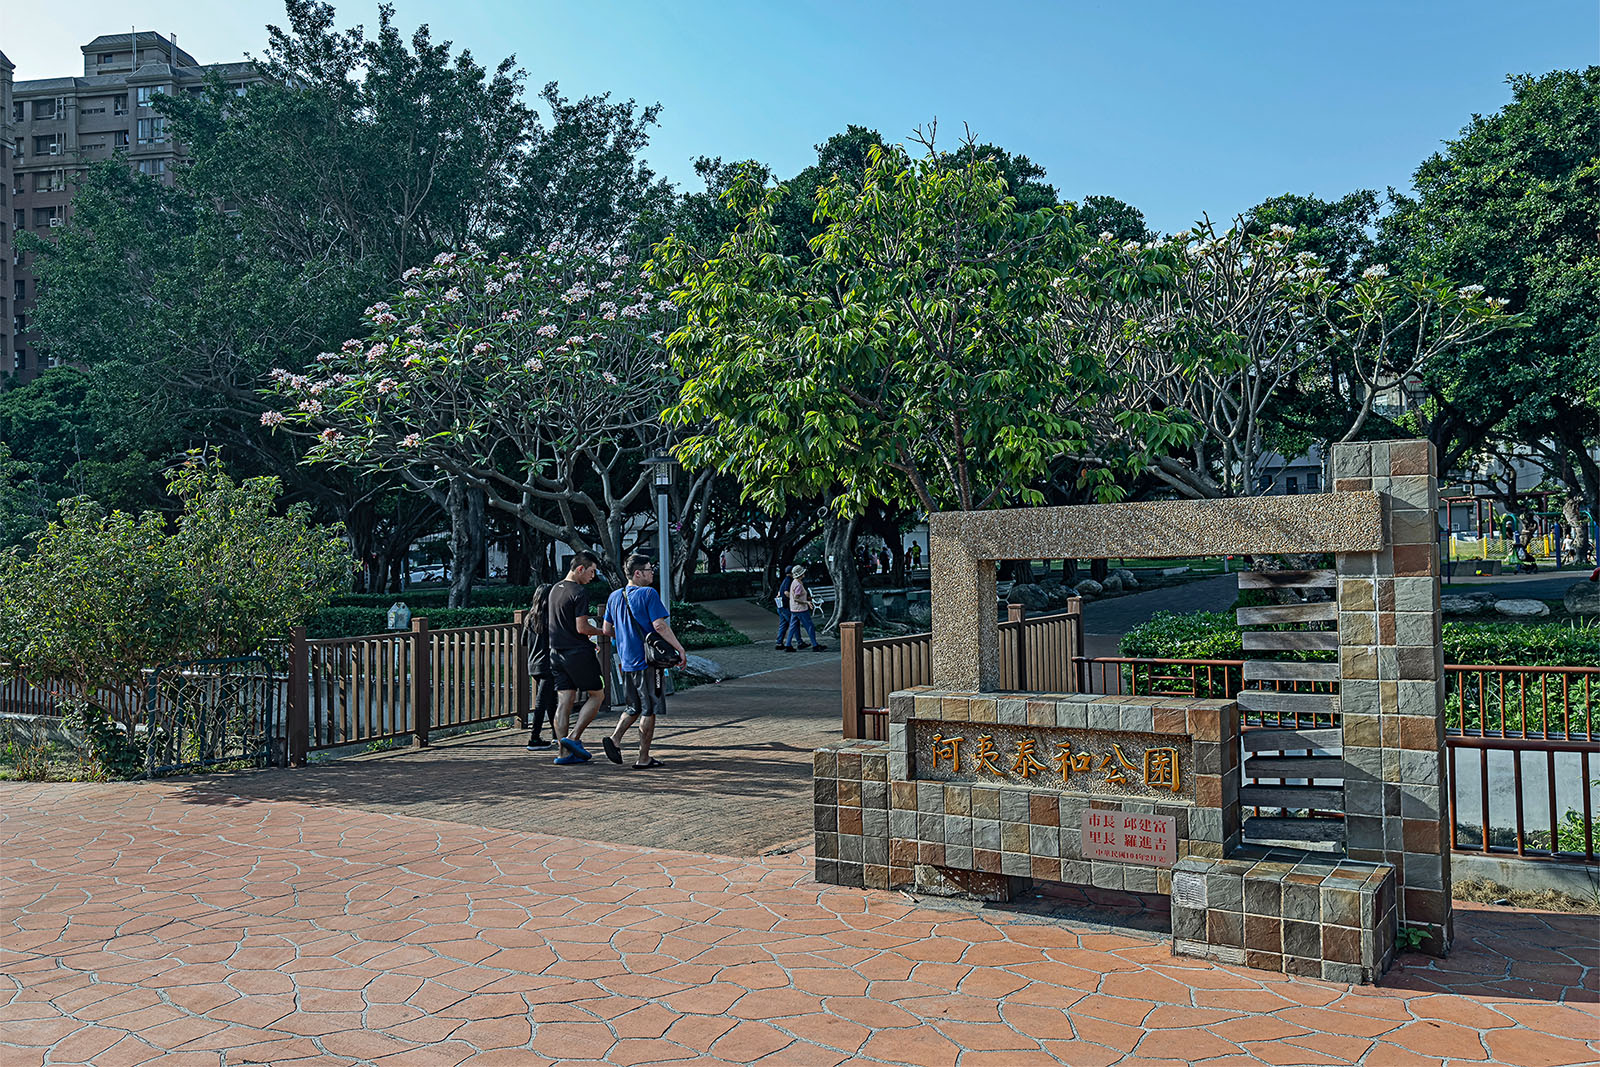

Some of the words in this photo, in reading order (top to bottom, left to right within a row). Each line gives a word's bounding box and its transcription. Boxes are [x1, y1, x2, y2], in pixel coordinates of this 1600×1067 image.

[932, 733, 1180, 792] 阿夷泰和公園
[1089, 813, 1115, 828] 市長
[1123, 816, 1167, 833] 邱建富
[1089, 831, 1116, 846] 里長
[1124, 834, 1167, 851] 羅進吉
